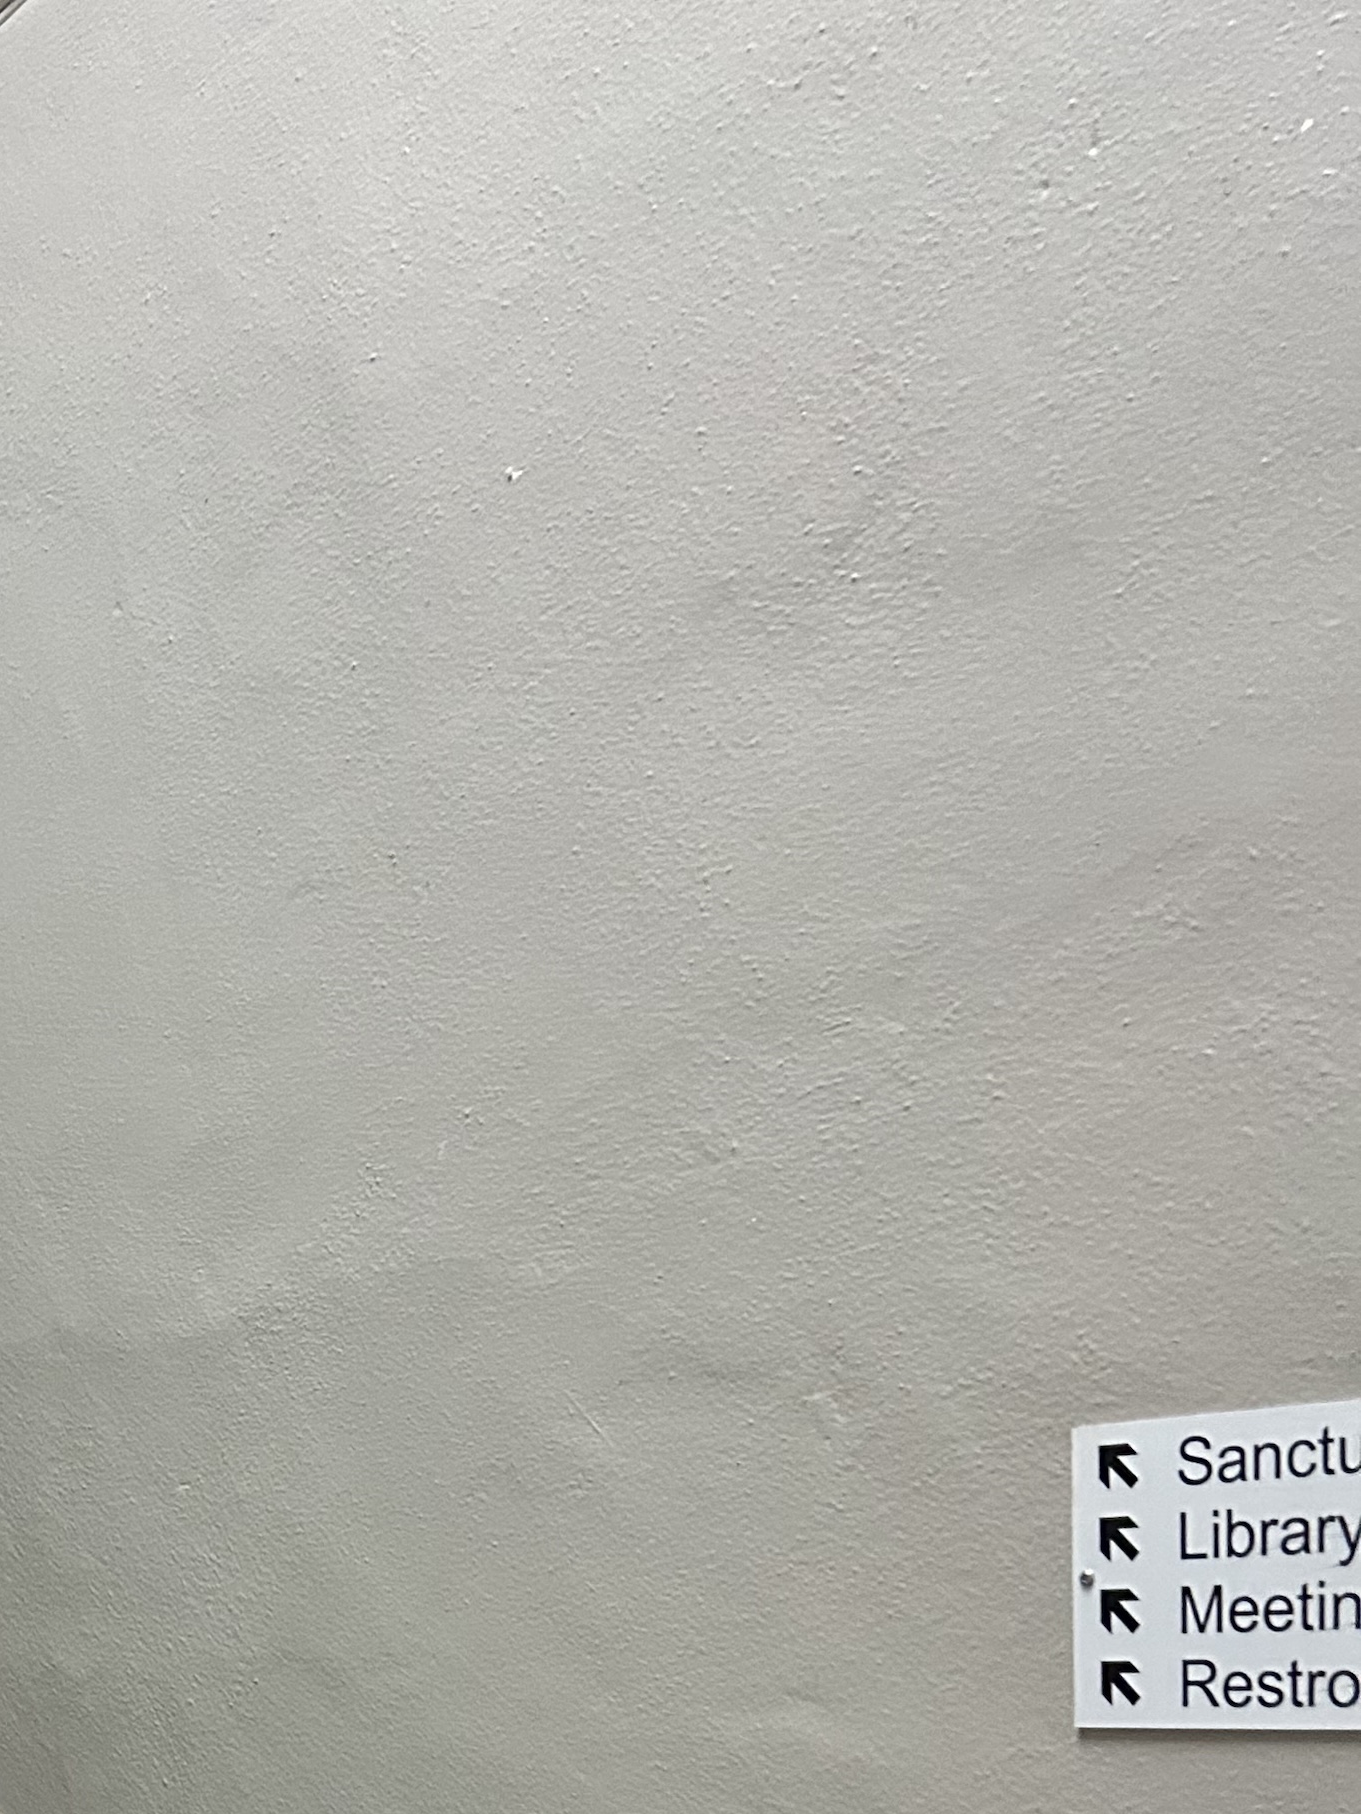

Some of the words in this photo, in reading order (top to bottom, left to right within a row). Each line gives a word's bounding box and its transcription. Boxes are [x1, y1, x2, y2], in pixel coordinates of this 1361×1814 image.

[1178, 1426, 1361, 1486] Sanctu
[1180, 1509, 1361, 1567] Library
[1181, 1580, 1361, 1635] Meetin
[1182, 1658, 1361, 1709] Restro
